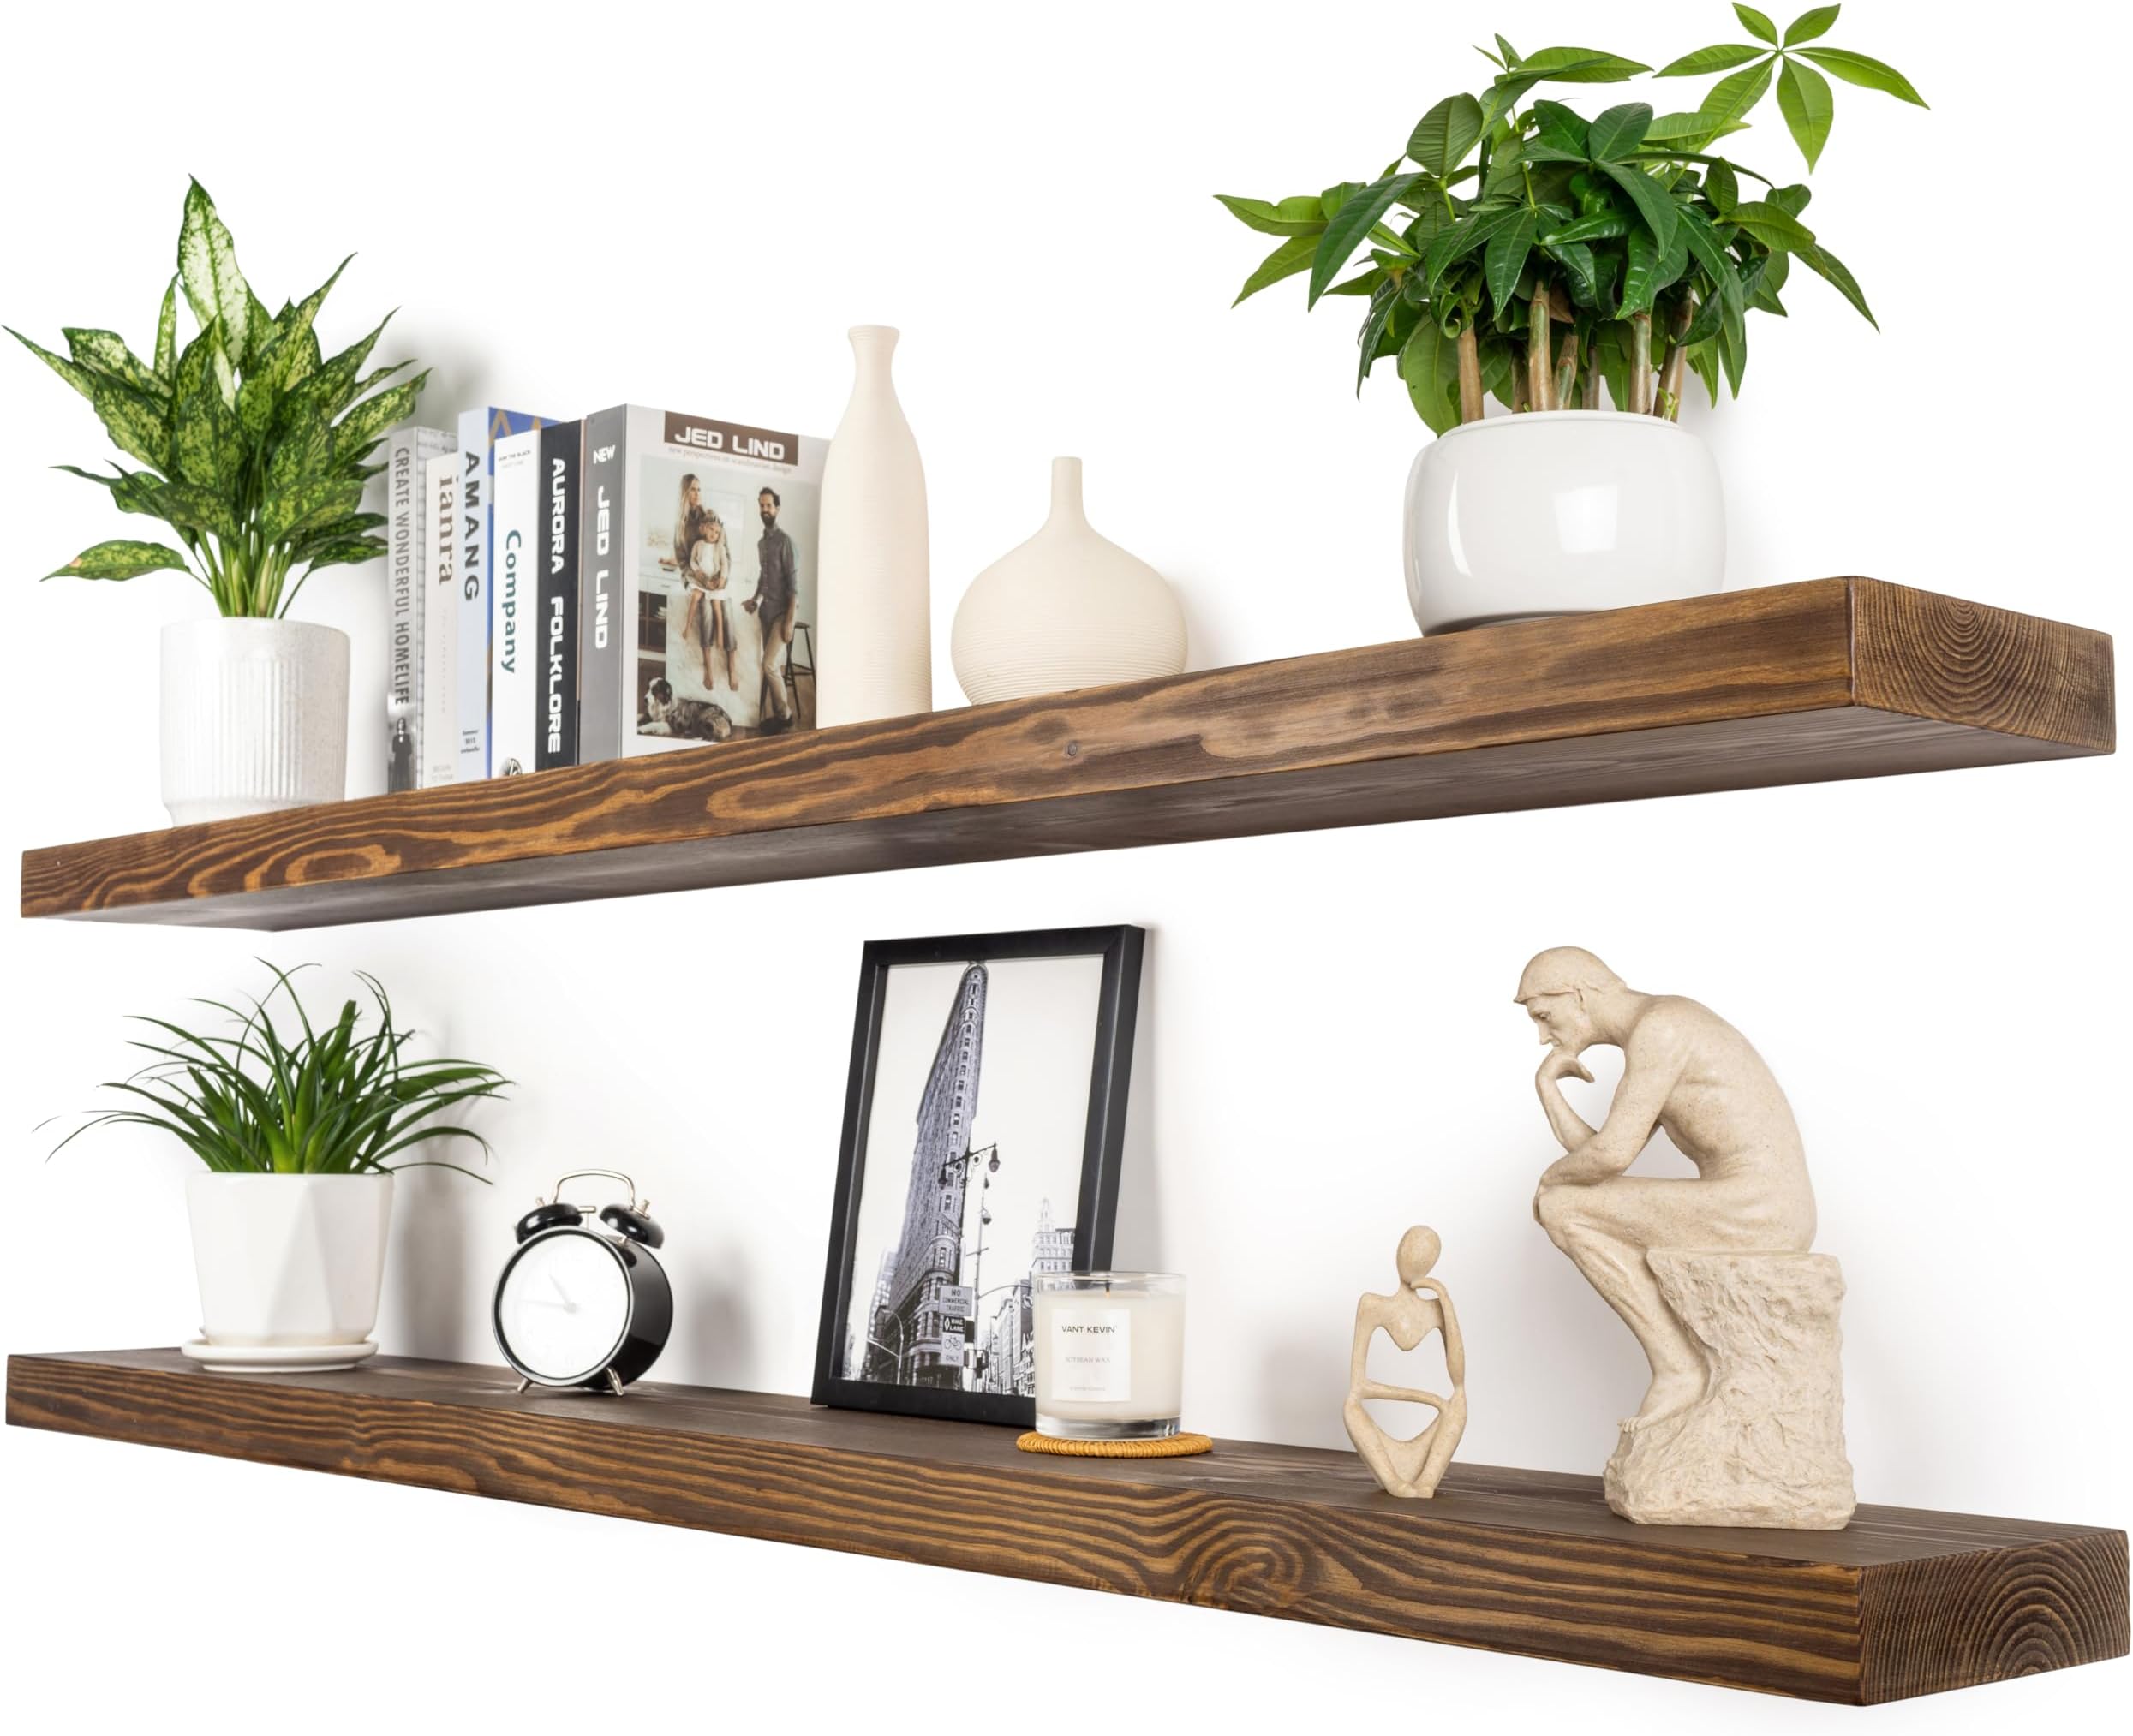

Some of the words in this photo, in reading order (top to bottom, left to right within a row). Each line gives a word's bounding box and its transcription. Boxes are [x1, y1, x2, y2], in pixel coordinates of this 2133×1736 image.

[395, 447, 409, 507] CREATE
[593, 444, 616, 464] NEW
[675, 426, 723, 450] JED
[732, 435, 785, 460] LIND
[464, 450, 480, 601] AMANG
[551, 458, 566, 574] AURORA
[597, 486, 610, 556] JED
[395, 511, 409, 617] WONDERFUL
[501, 529, 522, 674] Company
[595, 569, 609, 649] LIND
[395, 622, 409, 706] HOMELIFE
[547, 597, 564, 754] FOLKLORE
[949, 1324, 965, 1333] LANE
[1061, 1325, 1084, 1333] VANT
[1086, 1325, 1115, 1333] KEVIN
